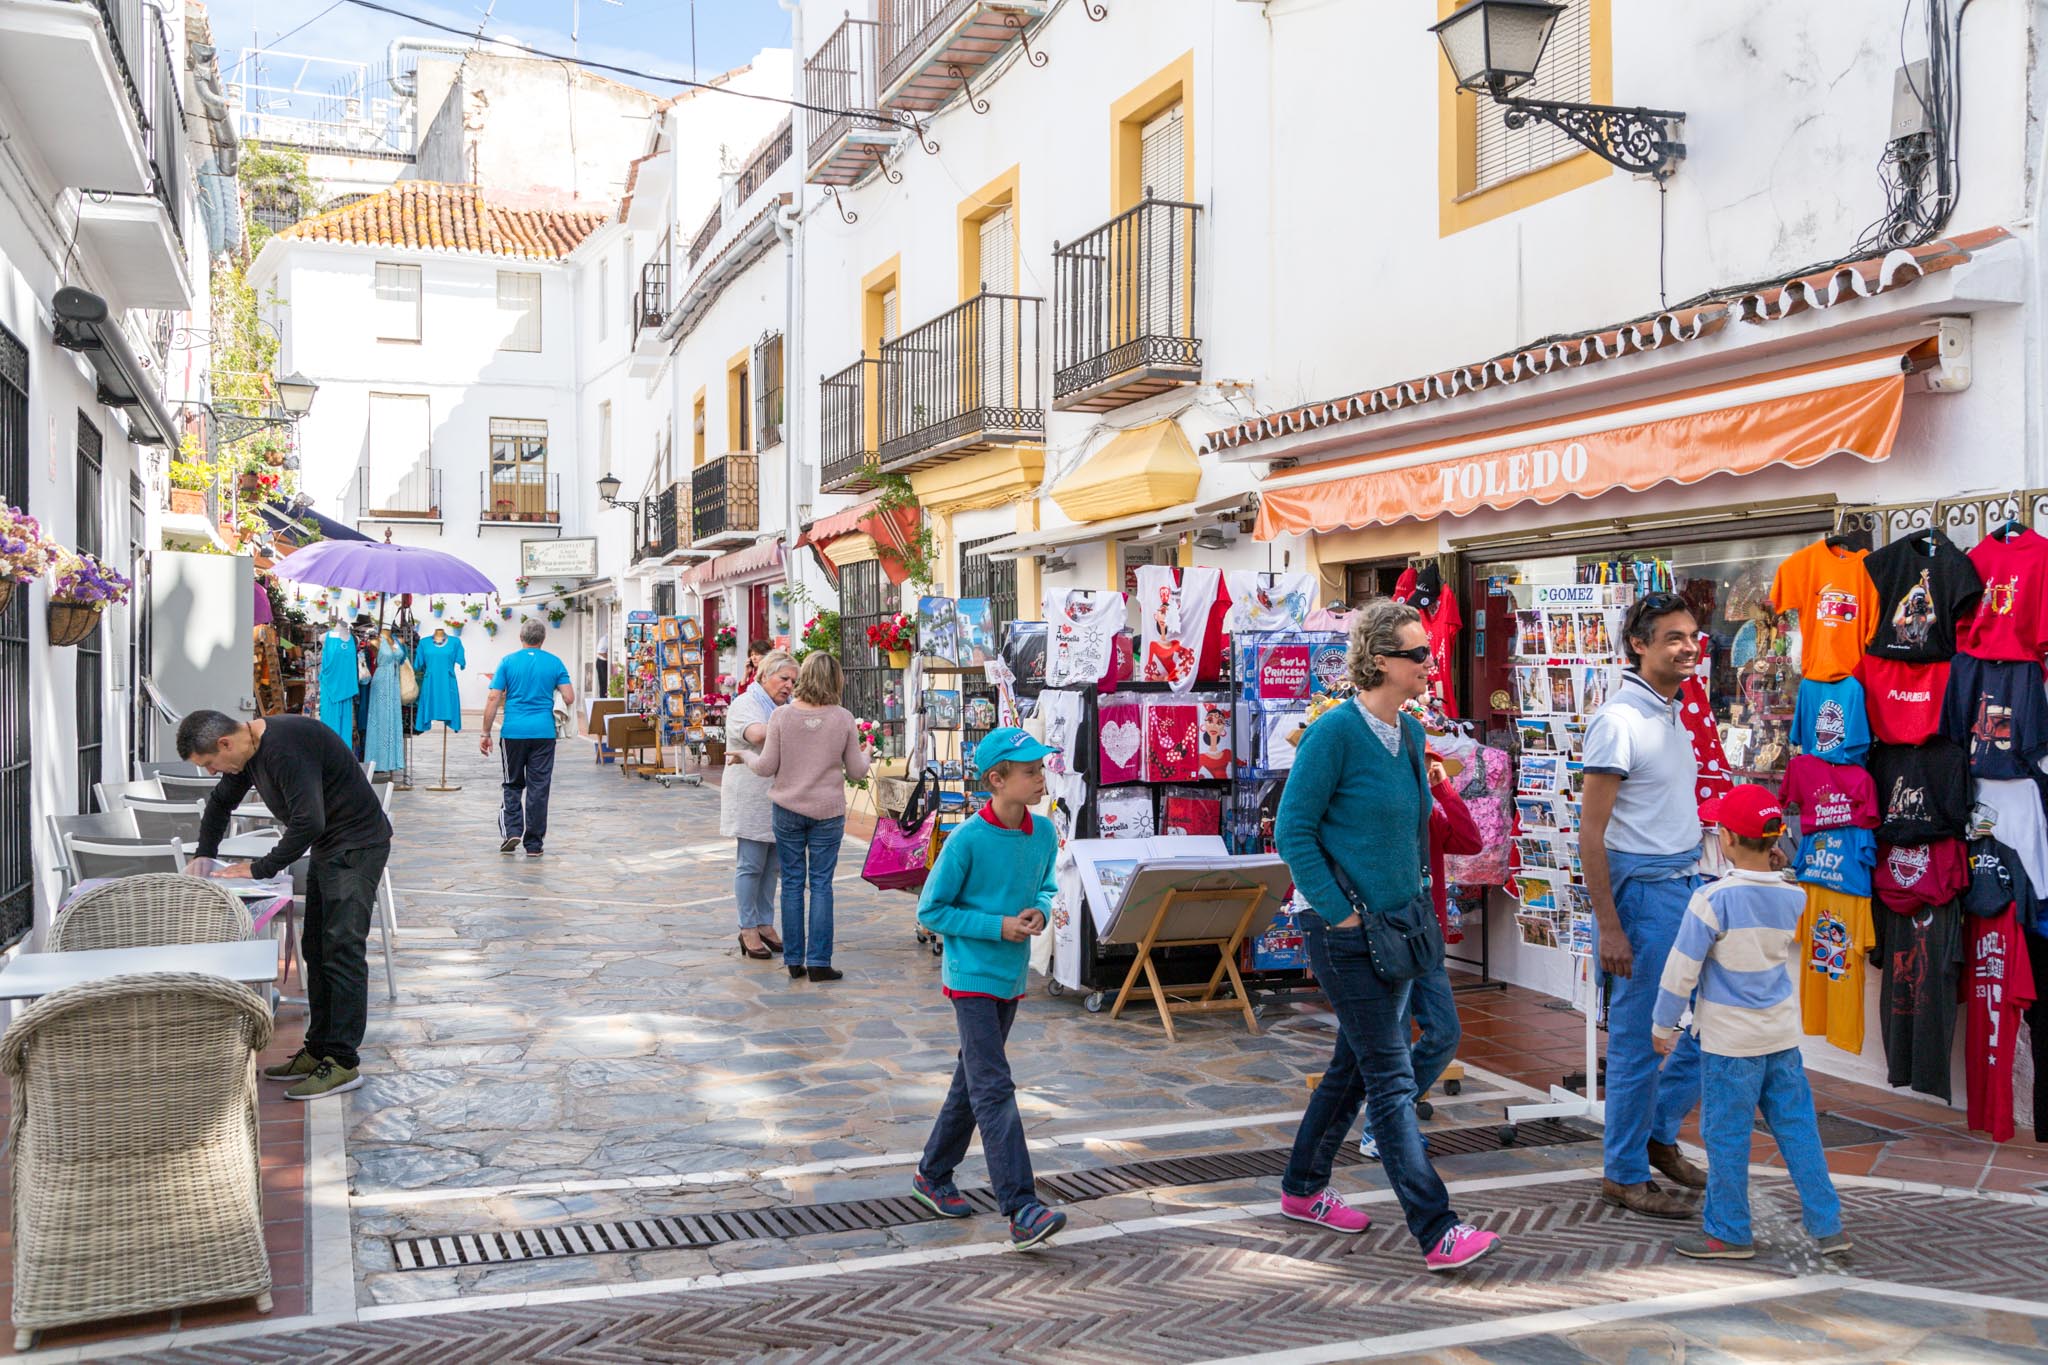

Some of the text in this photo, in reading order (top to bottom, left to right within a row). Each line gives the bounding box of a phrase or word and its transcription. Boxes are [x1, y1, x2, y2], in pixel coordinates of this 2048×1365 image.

[1438, 442, 1588, 503] TOLEDO
[1549, 587, 1594, 601] GOMEZ
[1815, 848, 1844, 870] REY
